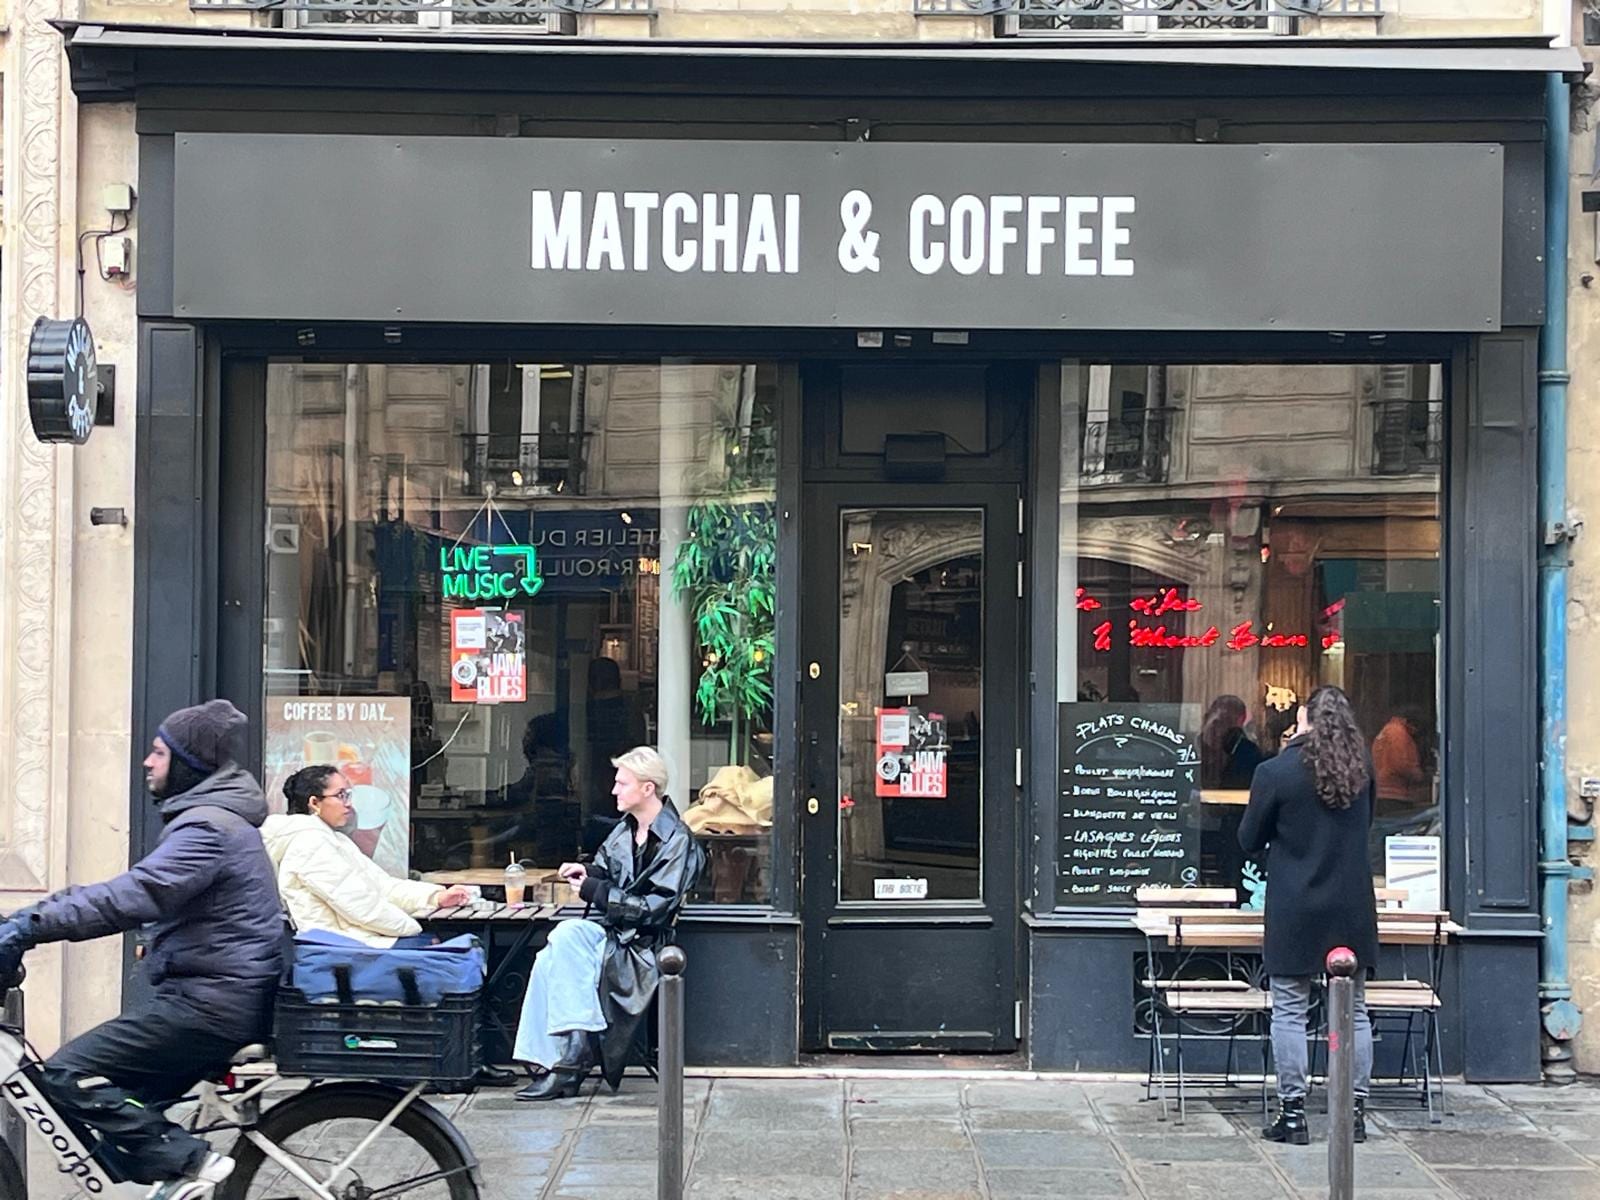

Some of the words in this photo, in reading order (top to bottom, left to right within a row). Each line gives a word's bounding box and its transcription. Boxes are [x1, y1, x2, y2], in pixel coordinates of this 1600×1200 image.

[531, 190, 800, 273] MATCHAI
[838, 189, 880, 273] &
[909, 194, 1135, 275] COFFEE
[440, 547, 492, 571] LIVE
[442, 572, 517, 598] MUSIC
[487, 653, 523, 676] JAM
[477, 676, 522, 698] BLUES
[283, 702, 332, 721] COFFEE
[336, 702, 355, 721] BY
[1075, 714, 1125, 740] PLATS
[1130, 717, 1185, 745] CHAUDS
[911, 751, 944, 774] JAM
[900, 773, 943, 796] BLUES
